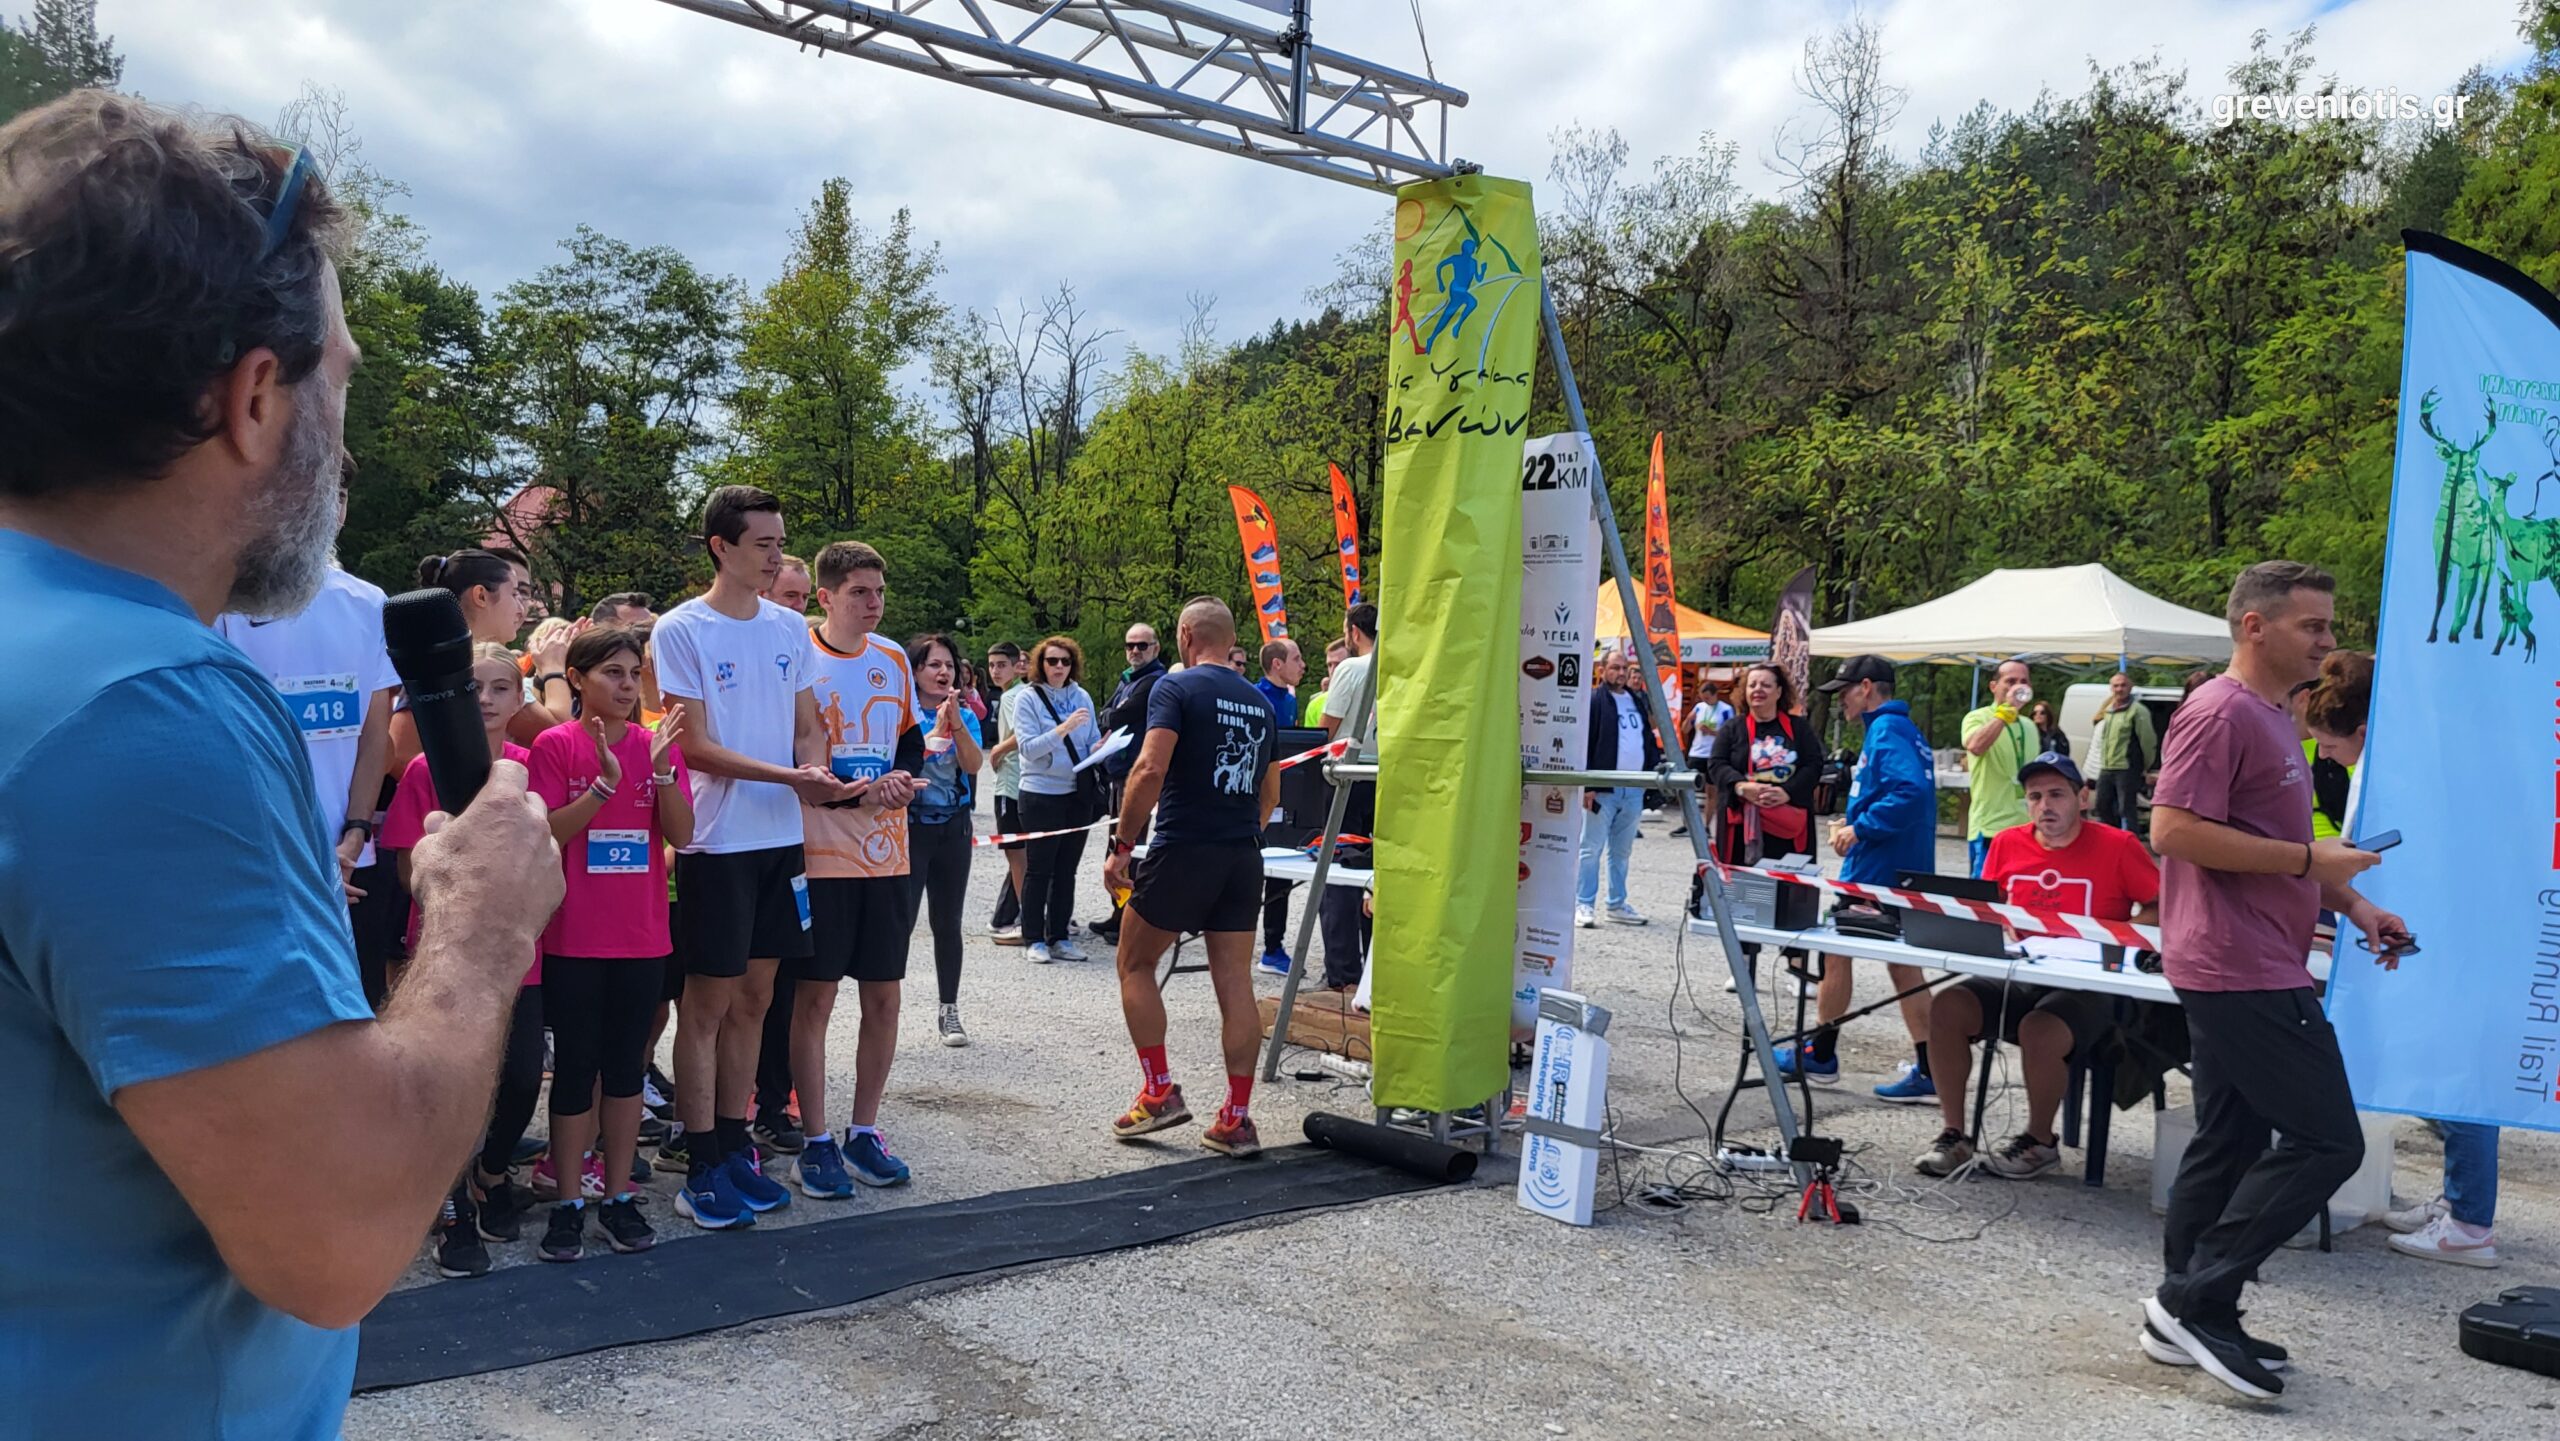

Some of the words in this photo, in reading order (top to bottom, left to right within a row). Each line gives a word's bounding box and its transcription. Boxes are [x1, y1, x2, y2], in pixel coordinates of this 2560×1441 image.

[1522, 453, 1557, 491] 22
[1557, 467, 1588, 489] KM
[416, 689, 456, 702] VONYX
[303, 700, 345, 723] 418
[1216, 697, 1266, 719] KASTRAKI
[1217, 713, 1246, 728] TRAIL
[609, 847, 631, 862] 92
[1533, 1035, 1553, 1113] timekeeping
[1528, 1134, 1541, 1172] utions
